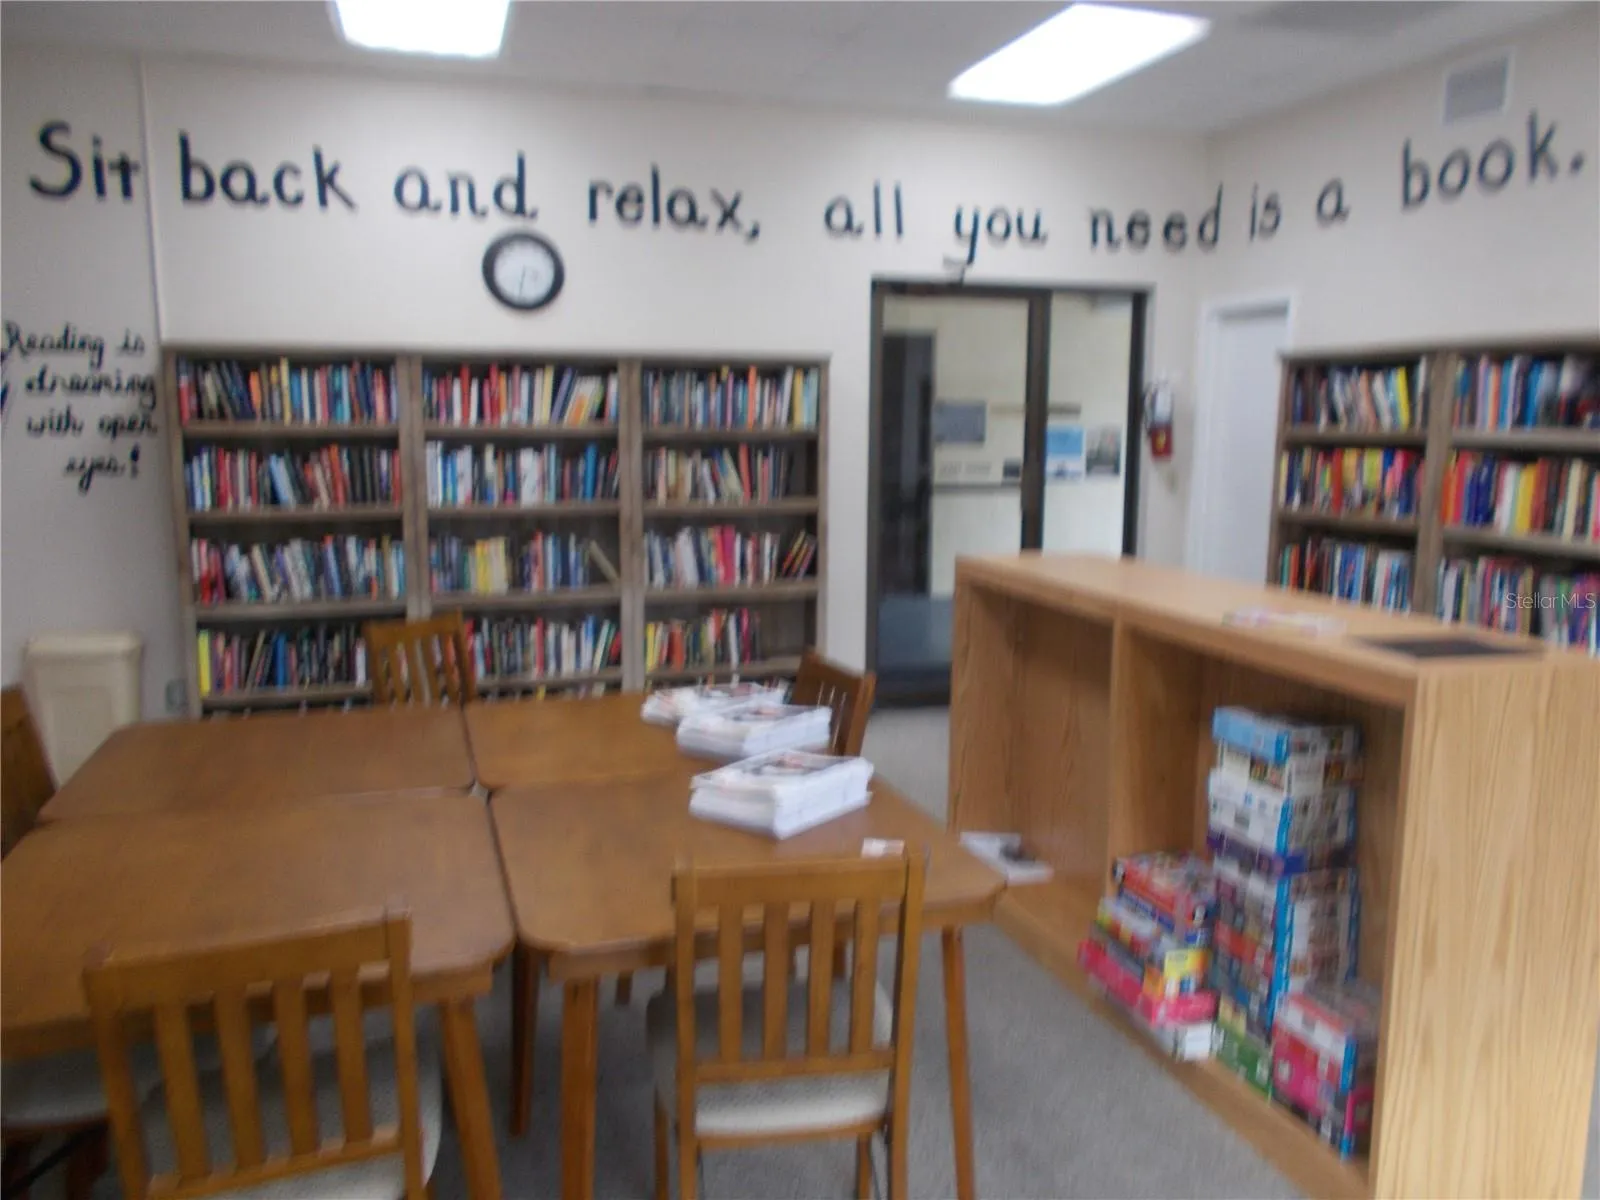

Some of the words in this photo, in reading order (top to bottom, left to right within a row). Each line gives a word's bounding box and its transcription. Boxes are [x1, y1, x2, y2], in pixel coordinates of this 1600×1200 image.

[28, 119, 141, 201] Sit
[180, 131, 356, 212] back
[394, 152, 538, 219] and
[587, 164, 761, 243] relax,
[824, 180, 905, 240] all
[953, 204, 1048, 265] you
[1089, 184, 1222, 252] need
[1248, 184, 1281, 242] is
[1316, 179, 1350, 225] a
[1402, 112, 1586, 212] book.
[3, 320, 104, 369] Reading
[118, 327, 146, 356] is
[26, 405, 84, 437] with
